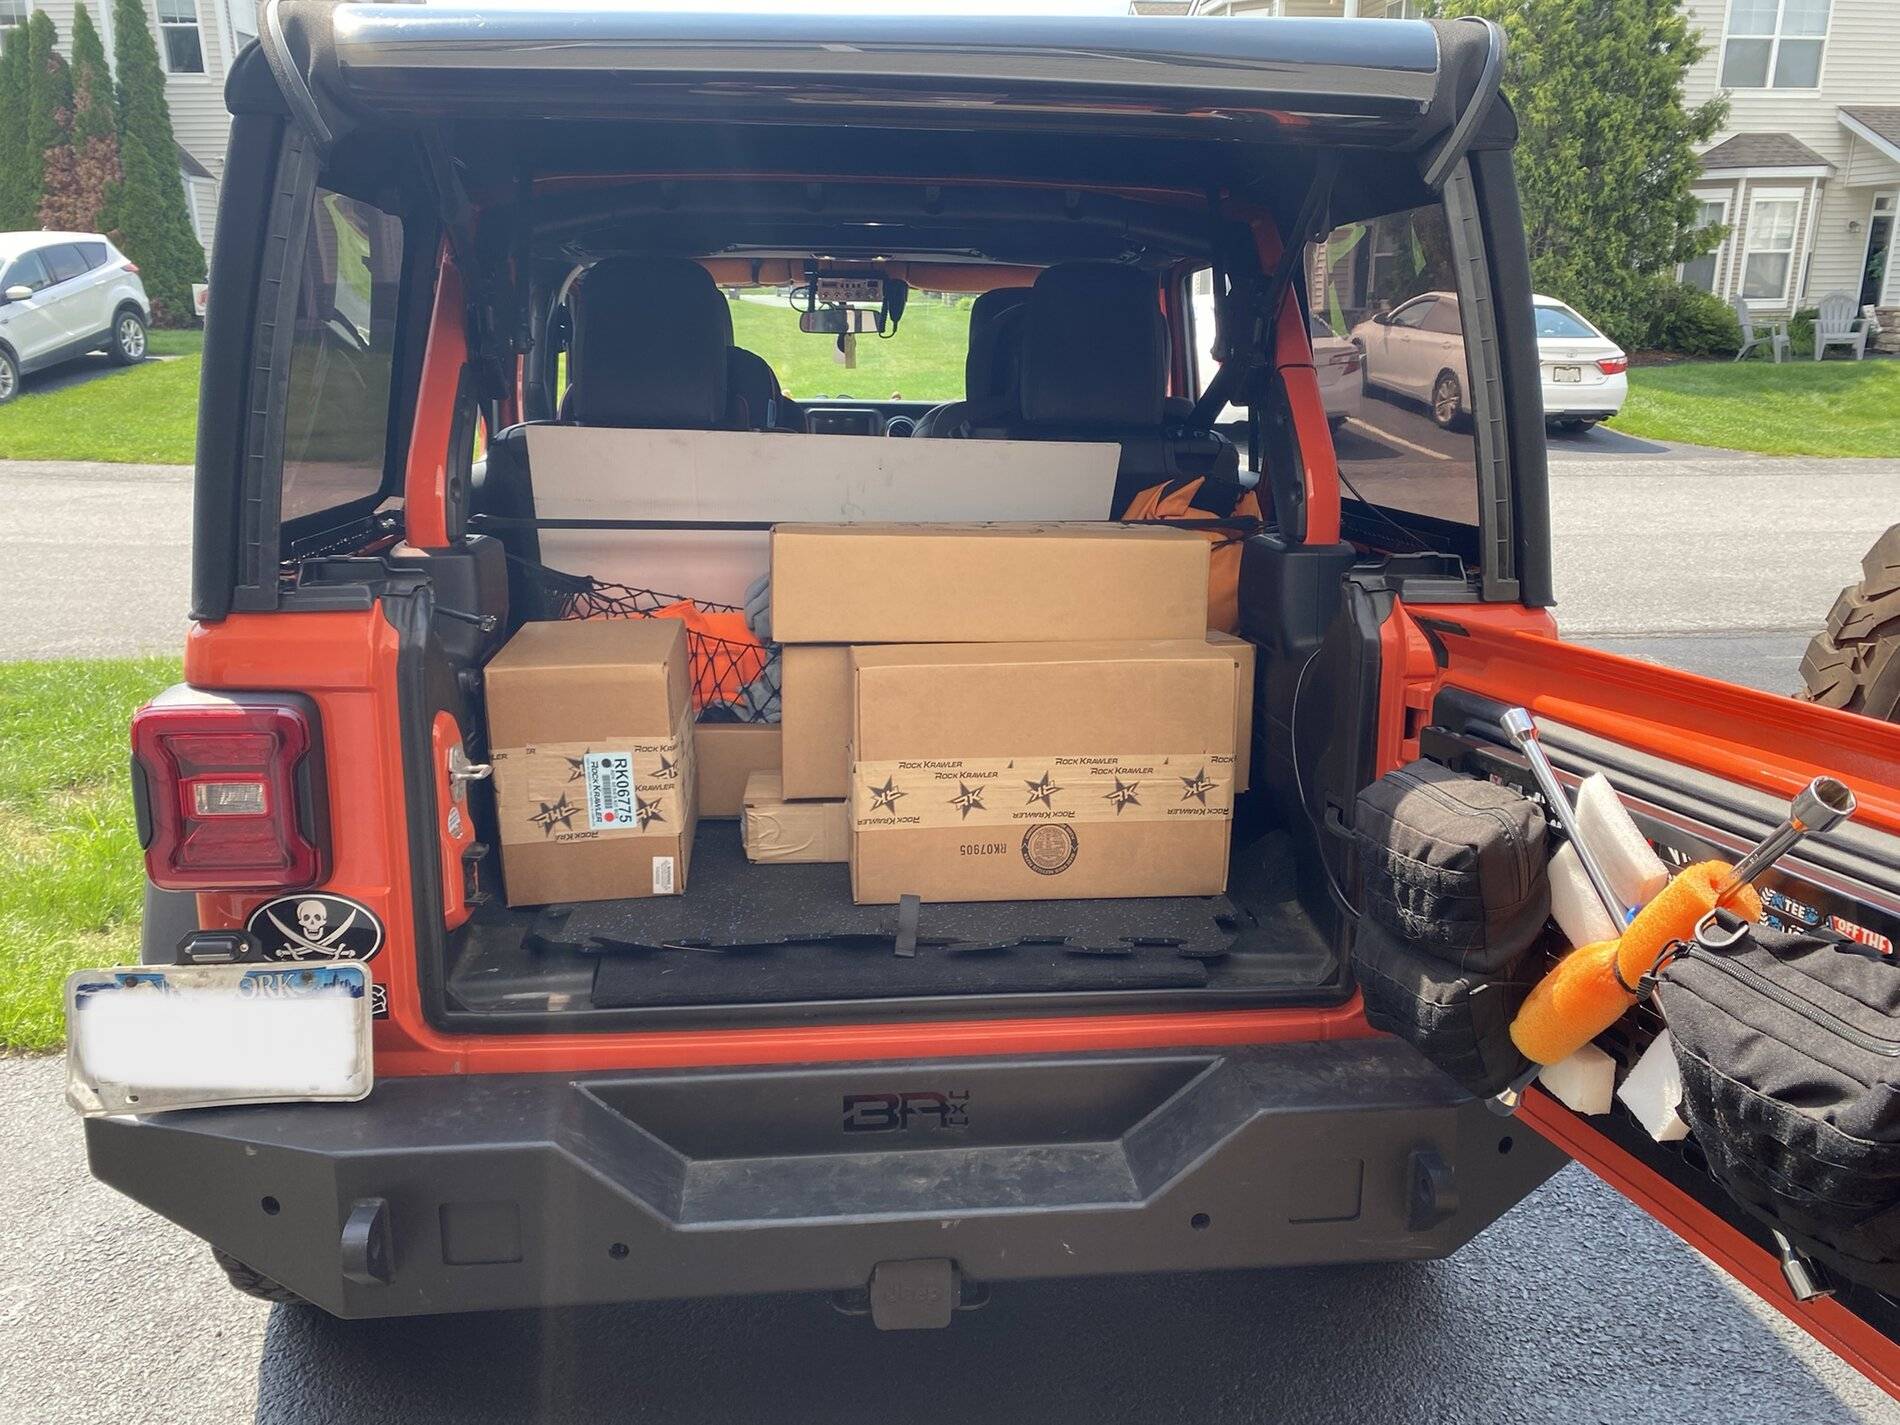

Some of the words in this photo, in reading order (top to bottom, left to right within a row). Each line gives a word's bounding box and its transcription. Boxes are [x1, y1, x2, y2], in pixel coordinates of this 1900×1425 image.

[898, 761, 922, 769] ROCK
[923, 760, 963, 768] KRAWLER
[1055, 757, 1078, 765] ROCK
[591, 761, 599, 784] ROCK
[1090, 767, 1113, 775] ROCK
[935, 772, 958, 780] ROCK
[614, 758, 632, 823] RK06775
[635, 783, 675, 792] KRAWLER
[593, 785, 602, 823] KRAWLER
[1013, 811, 1051, 819] KRAWLER
[857, 817, 895, 825] KRAWLER
[960, 843, 1007, 855] RK07905
